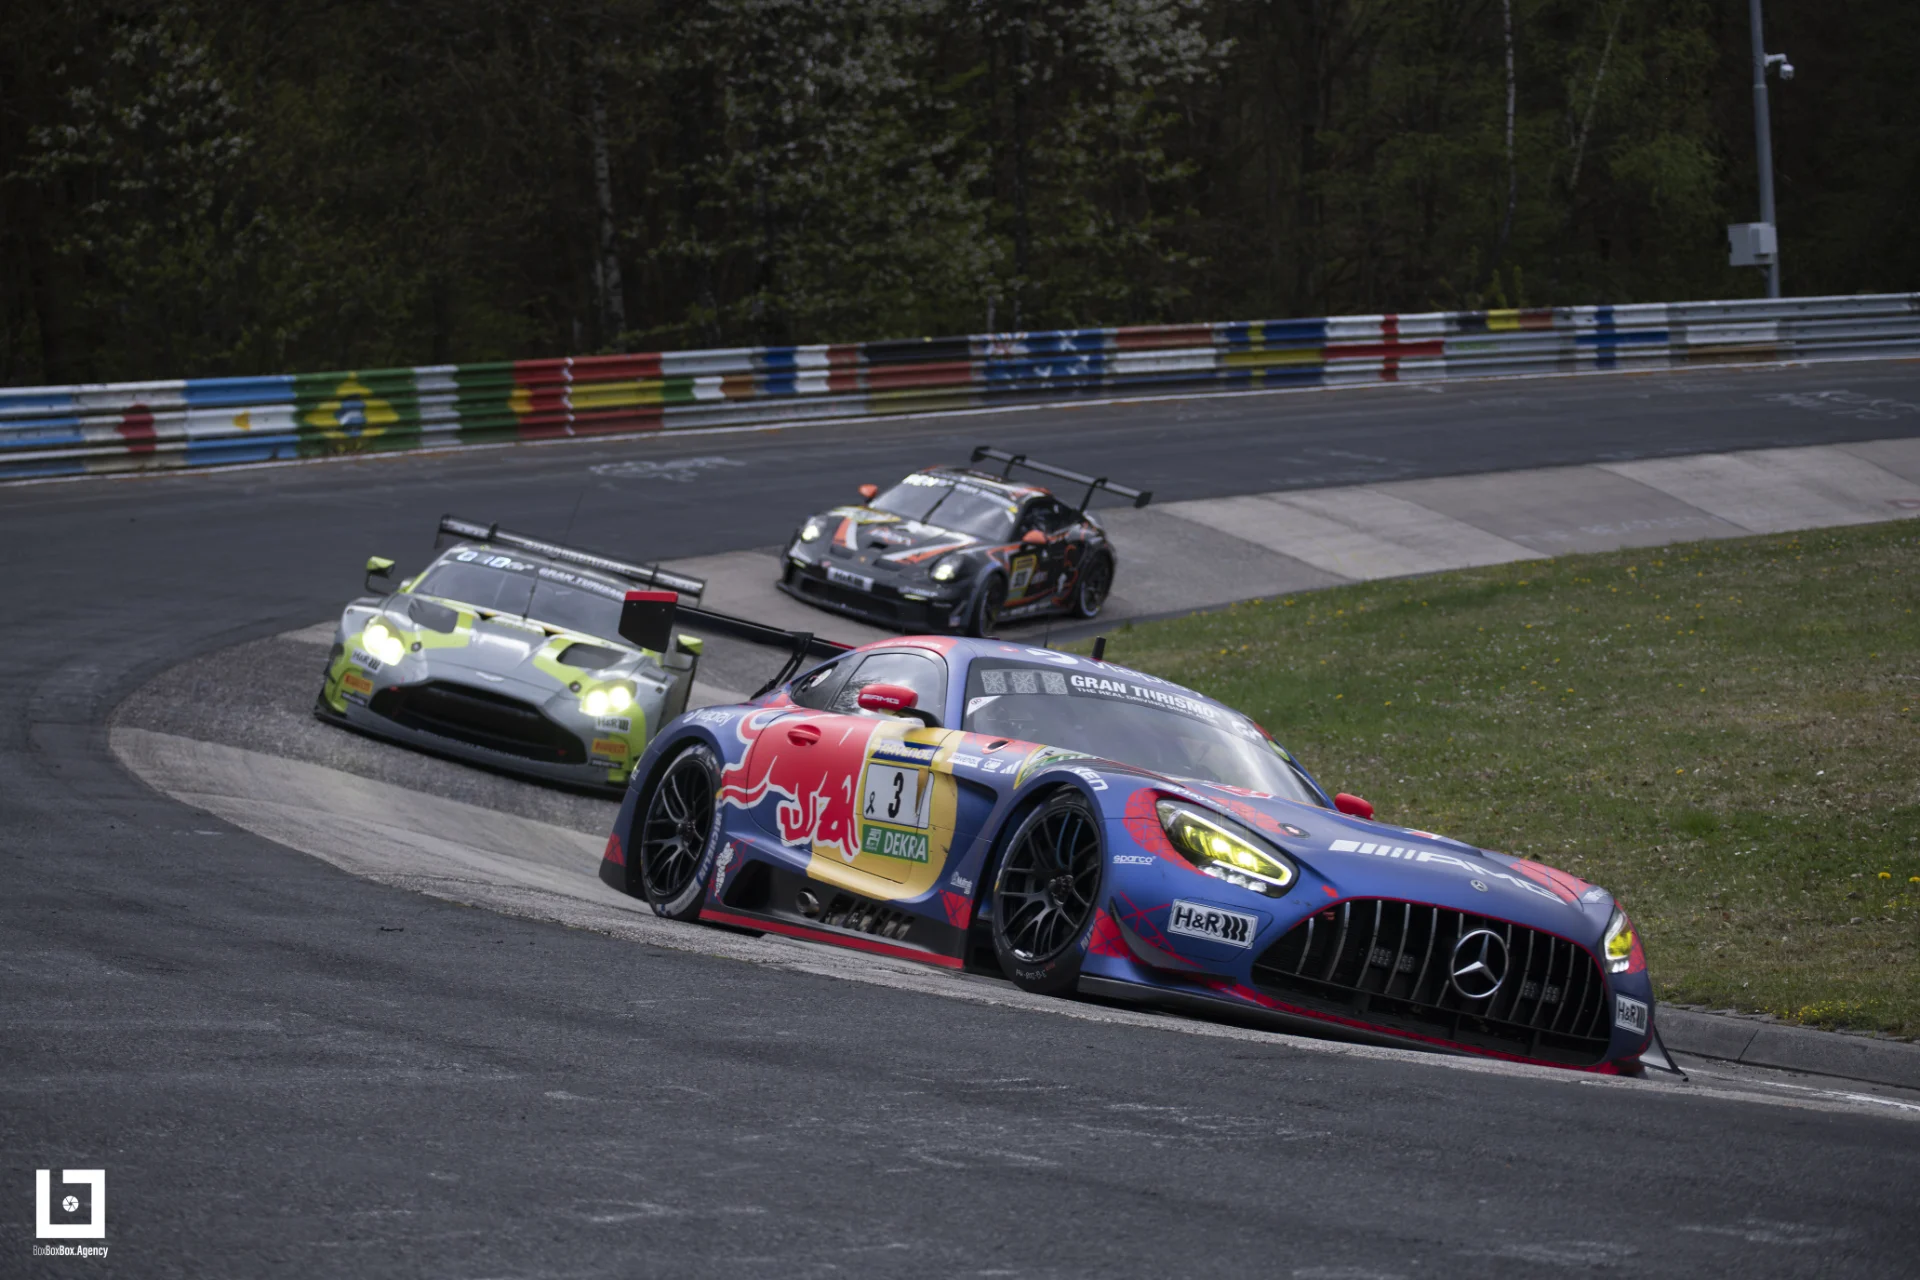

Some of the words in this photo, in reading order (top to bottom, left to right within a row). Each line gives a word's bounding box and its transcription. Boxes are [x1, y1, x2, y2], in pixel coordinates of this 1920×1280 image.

[1070, 675, 1127, 694] GRAN
[1130, 685, 1215, 718] TURISMO
[1098, 689, 1125, 699] REAL
[887, 771, 904, 819] 3
[883, 831, 927, 860] DEKRA
[1113, 854, 1152, 865] sparco
[1416, 851, 1569, 906] AMG
